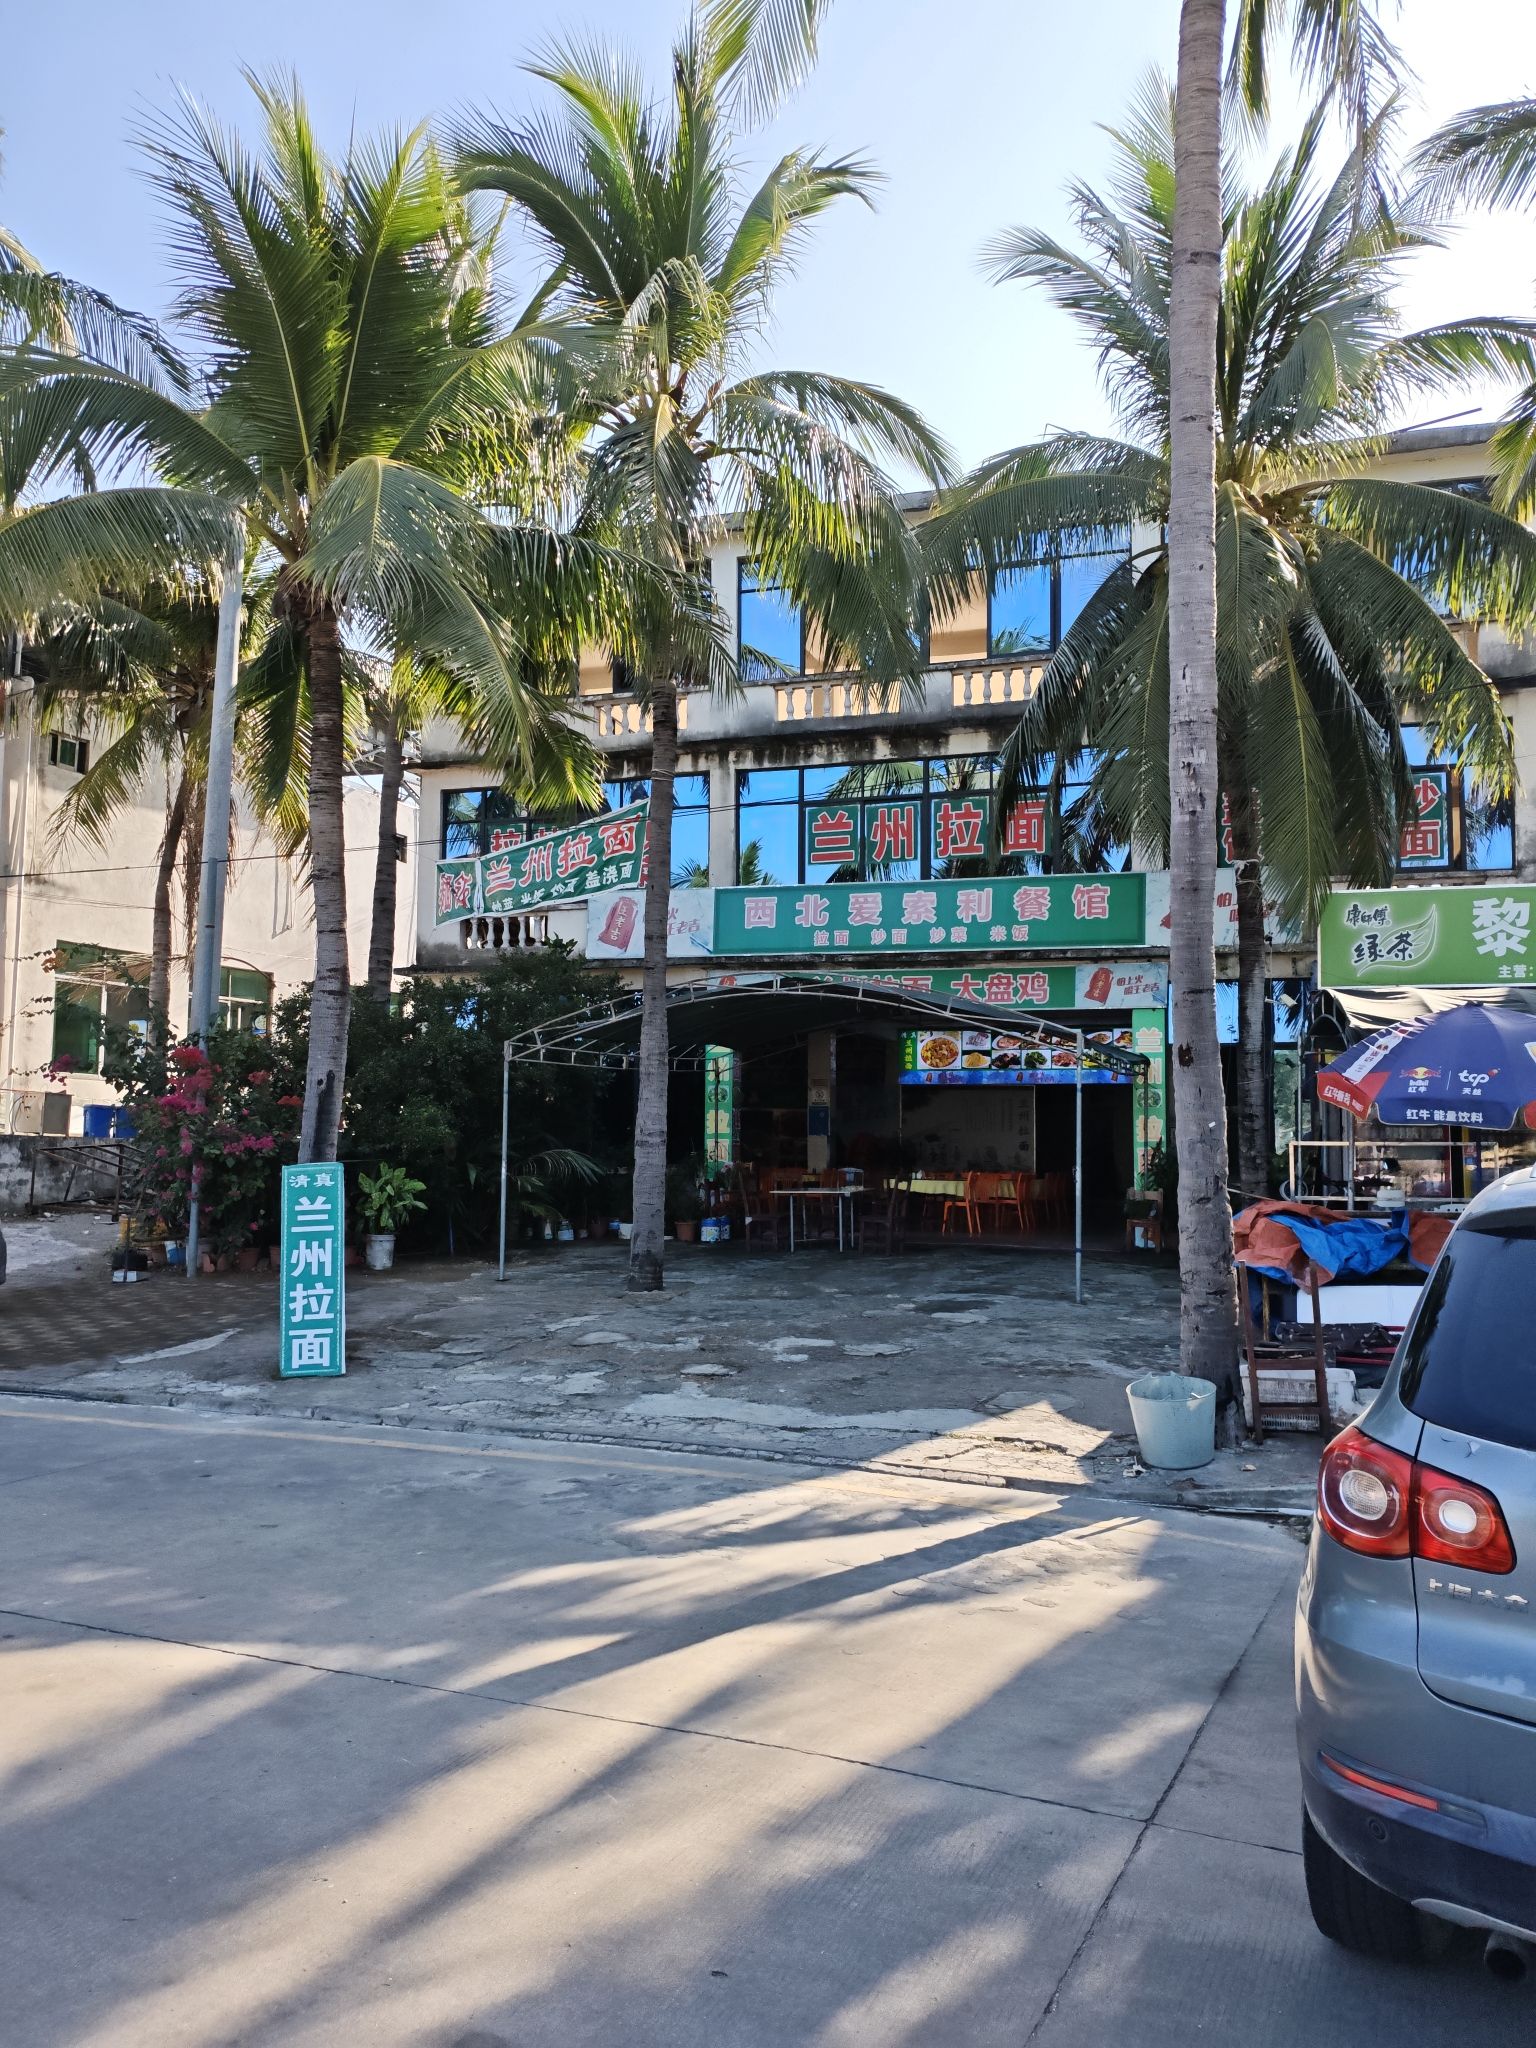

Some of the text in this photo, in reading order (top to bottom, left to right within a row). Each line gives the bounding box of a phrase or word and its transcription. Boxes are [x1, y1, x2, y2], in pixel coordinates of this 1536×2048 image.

[486, 812, 643, 897] 兰州拉面
[811, 800, 1046, 863] 兰州拉面
[744, 883, 1110, 929] 西北爱索利餐馆
[1472, 897, 1531, 958] 黎
[814, 925, 1029, 946] 拉面 炒面 炒菜 米饭
[1353, 930, 1414, 964] 绿茶
[951, 972, 1050, 1005] 大盘鸡
[289, 1172, 335, 1188] 清真
[289, 1195, 335, 1369] 兰州拉面
